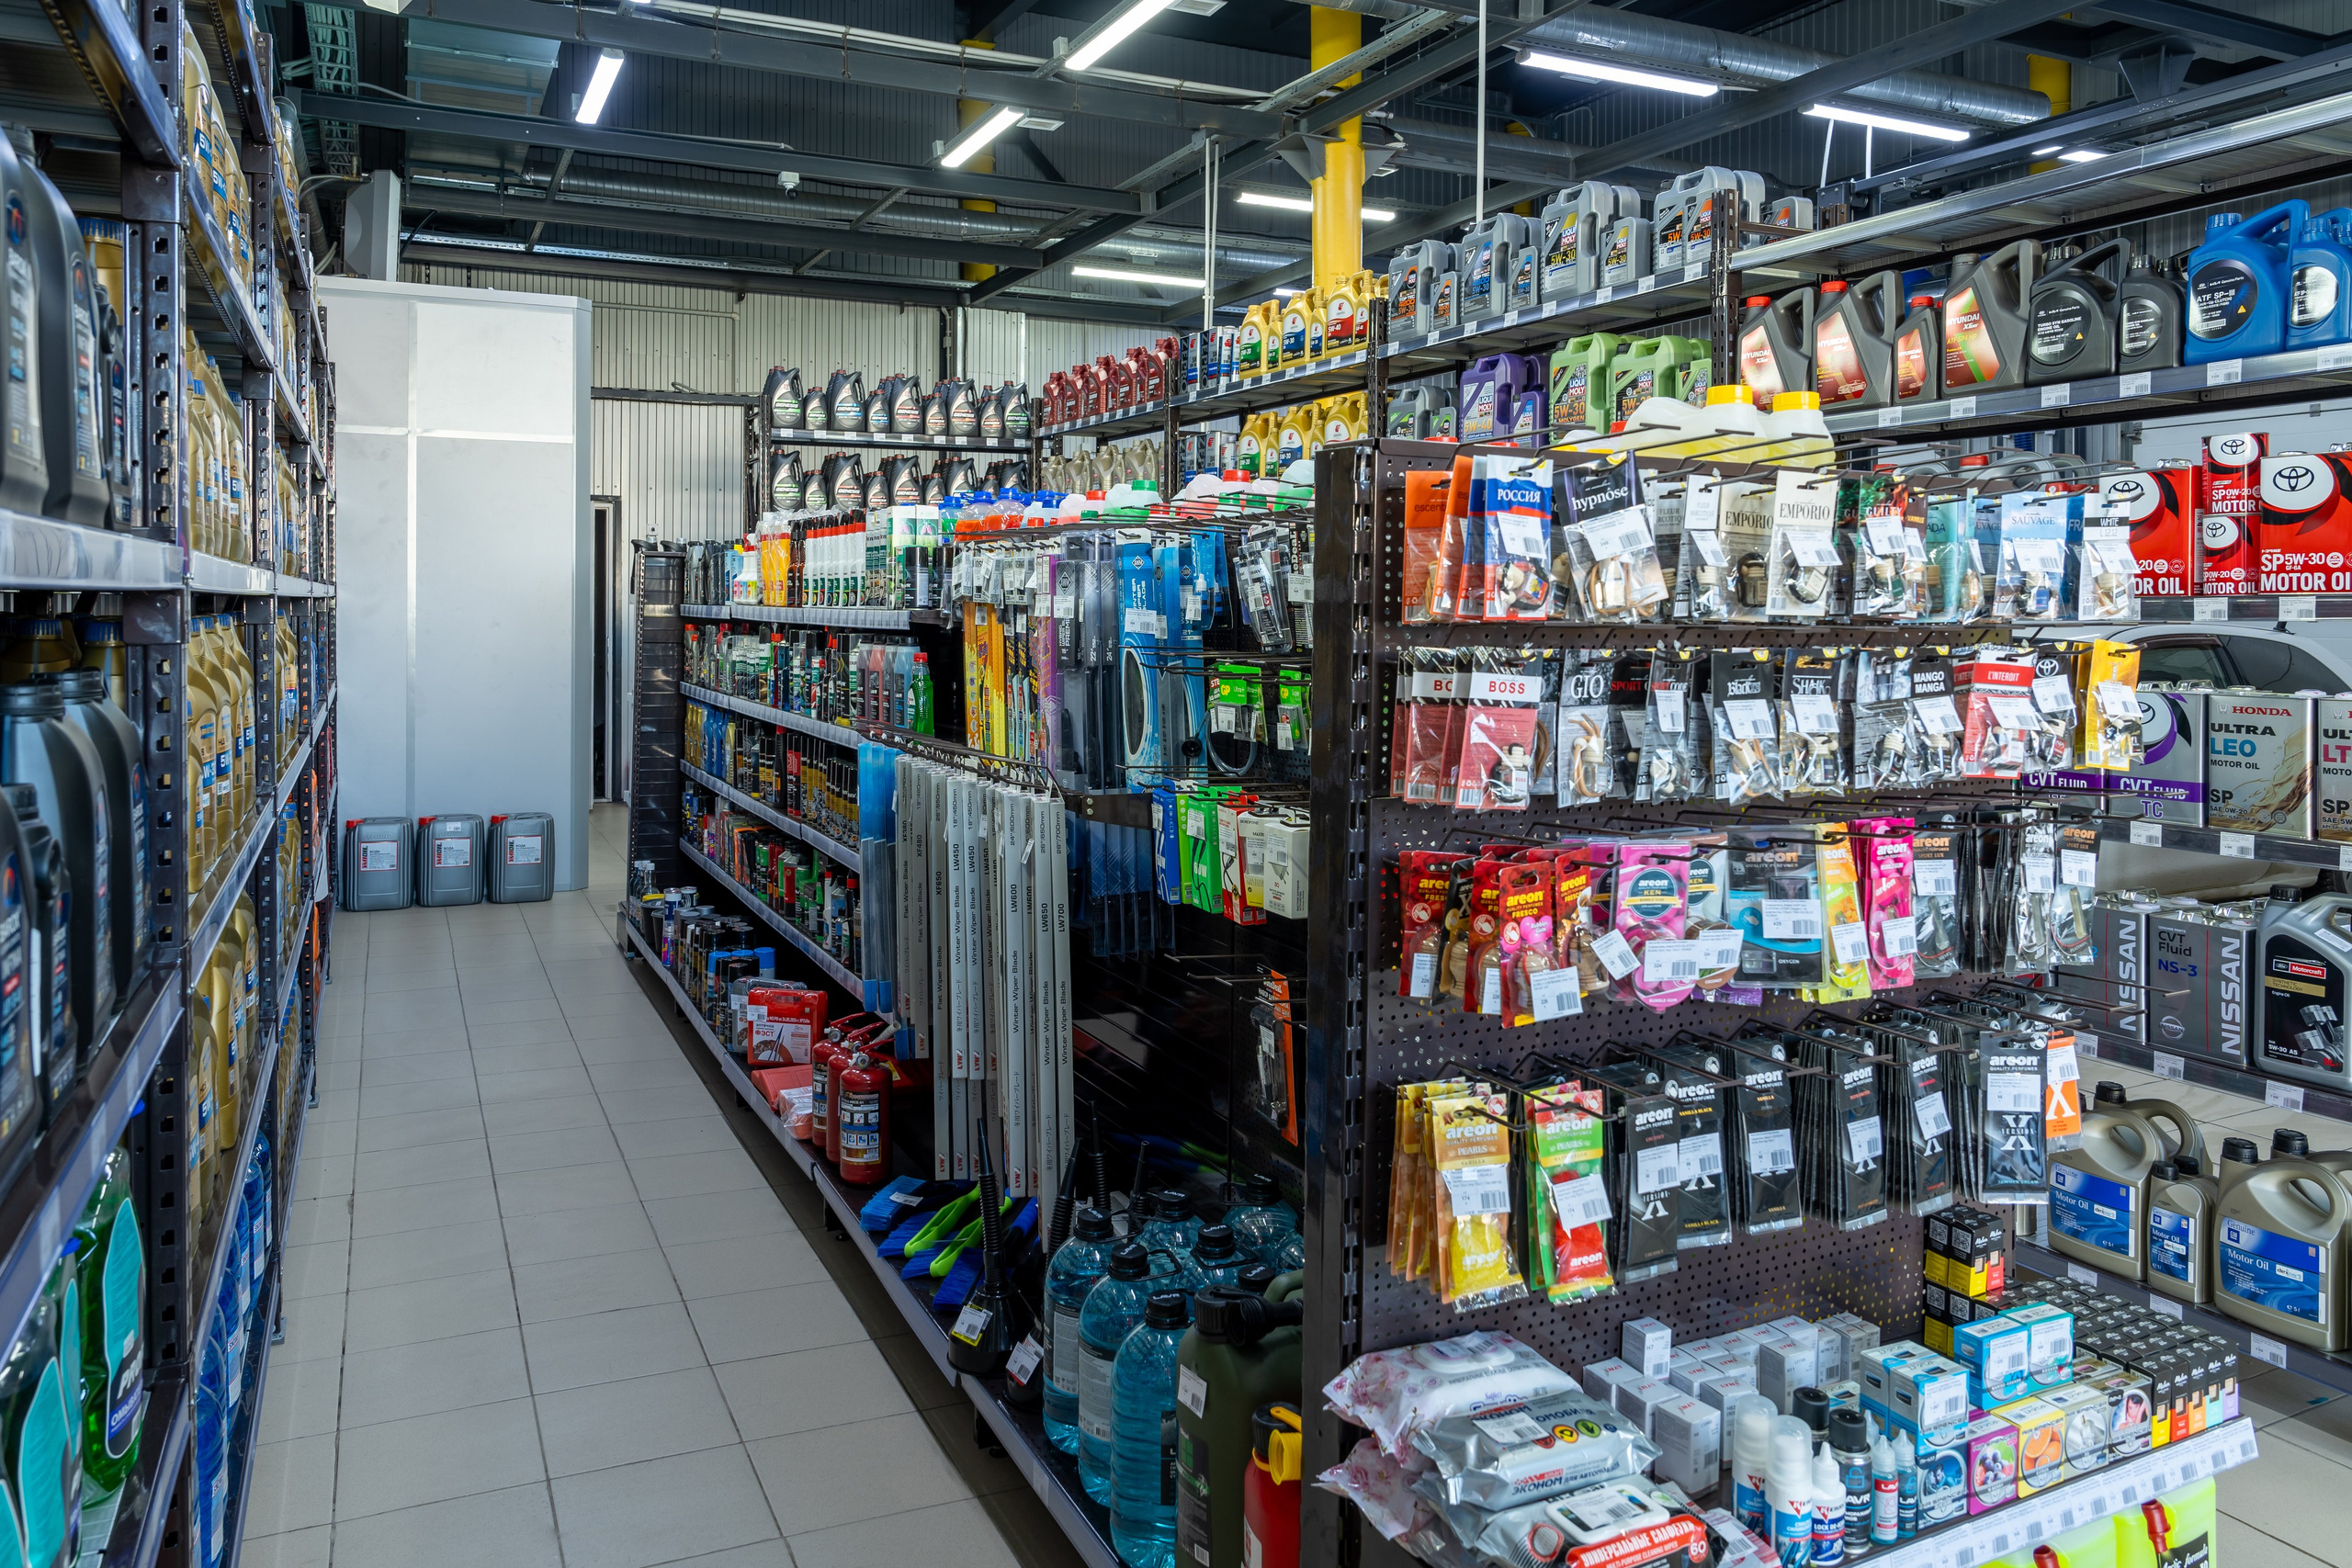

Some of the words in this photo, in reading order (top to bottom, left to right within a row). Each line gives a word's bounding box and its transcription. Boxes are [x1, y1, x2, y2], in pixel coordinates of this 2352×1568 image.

[1562, 227, 1576, 237] LIQUI
[1690, 229, 1711, 241] 5W-30
[1561, 233, 1576, 245] MOLY
[1551, 249, 1576, 265] 5W-30
[1608, 254, 1626, 265] 5W-30
[1472, 284, 1490, 295] 5W-30
[2197, 293, 2211, 303] ATF
[1398, 304, 1415, 315] 5W-30
[1947, 313, 1980, 325] HYUNDAI
[1818, 336, 1849, 348] HYUNDAI
[1201, 332, 1209, 389] ZEPRO
[1741, 349, 1770, 361] HYUNDAI
[1181, 337, 1189, 393] ZEPRO
[1569, 378, 1585, 388] LIQUI
[1568, 386, 1585, 396] MOLY
[1479, 395, 1492, 404] LIQUI
[1478, 401, 1492, 412] MOLY
[1554, 401, 1585, 418] 5W-30
[1558, 415, 1585, 423] MOLYGEN
[1464, 419, 1492, 433] 5W-40
[1497, 489, 1541, 503] РОССИЯ
[1571, 484, 1629, 512] hypnôse
[2212, 490, 2225, 500] SP
[2226, 488, 2251, 496] 0W-20
[1414, 502, 1446, 513] escent
[1780, 502, 1830, 521] EMPORIO
[1866, 506, 1903, 517] GUILTY
[2211, 500, 2256, 513] MOTOR
[1725, 511, 1773, 530] EMPORIO
[2011, 515, 2055, 525] SAUVAGE
[2099, 517, 2119, 527] WHITE
[2261, 554, 2284, 571] SP
[2285, 552, 2325, 565] 5W-30
[2209, 570, 2230, 579] 0W-20
[2261, 572, 2326, 591] MOTOR
[2331, 571, 2352, 591] OI
[2159, 577, 2185, 594] OIL
[2238, 581, 2258, 593] OIL
[1913, 671, 1945, 682] MANGO
[1987, 671, 2019, 682] L'INTERDIT
[1221, 684, 1231, 695] GP
[1281, 687, 1289, 698] GP
[1488, 681, 1525, 694] BOSS
[1571, 674, 1604, 699] GIO
[1611, 681, 1642, 691] SPORT
[1915, 681, 1946, 694] MANGA
[2232, 705, 2293, 716] HONDA
[2211, 722, 2277, 737] ULTRA
[2211, 739, 2256, 758] LEO
[2211, 759, 2243, 769] MOTOR
[2245, 761, 2260, 770] OIL
[2323, 767, 2352, 776] MOTO
[2029, 773, 2057, 786] CVT
[2120, 777, 2153, 795] CVT
[2210, 788, 2233, 803] SP
[2141, 800, 2164, 818] TC
[2224, 807, 2248, 816] 0W-20
[2322, 799, 2350, 815] SP
[2063, 827, 2097, 840] areon
[1876, 842, 1908, 855] areon
[1913, 837, 1950, 848] areon
[1746, 852, 1799, 863] areon
[1561, 874, 1588, 892] areon
[1637, 879, 1668, 887] areon
[1506, 891, 1544, 907] areon
[1511, 908, 1538, 919] FRESCO
[2158, 930, 2186, 944] CVT
[2159, 942, 2192, 957] Fluid
[2158, 959, 2198, 976] NS-3
[2291, 965, 2323, 976] Motorcraft
[2222, 936, 2241, 1056] NISSAN
[2268, 1044, 2288, 1055] 5W-30
[1989, 1055, 2040, 1066] areon
[1746, 1069, 1782, 1085] areon
[1843, 1066, 1872, 1084] areon
[1635, 1106, 1674, 1124] areon
[1446, 1123, 1498, 1138] areon
[1546, 1119, 1592, 1134] areon
[1457, 1145, 1487, 1156] PEARLS
[2055, 1191, 2076, 1205] Motor
[2078, 1199, 2088, 1210] Oil
[2227, 1219, 2256, 1236] Genuine
[2152, 1228, 2169, 1241] Motor
[2170, 1234, 2180, 1244] Oil
[1570, 1251, 1602, 1267] areon
[2228, 1249, 2255, 1266] Motor
[2256, 1258, 2269, 1271] Oil
[1153, 1292, 1181, 1302] LAVR
[1512, 1478, 1563, 1495] ЭКОНОМ
[1814, 1523, 1829, 1531] LOCK
[1579, 1532, 1652, 1568] УНИВЕРСАЛЬНЫЕ
[1690, 1541, 1707, 1555] 60
